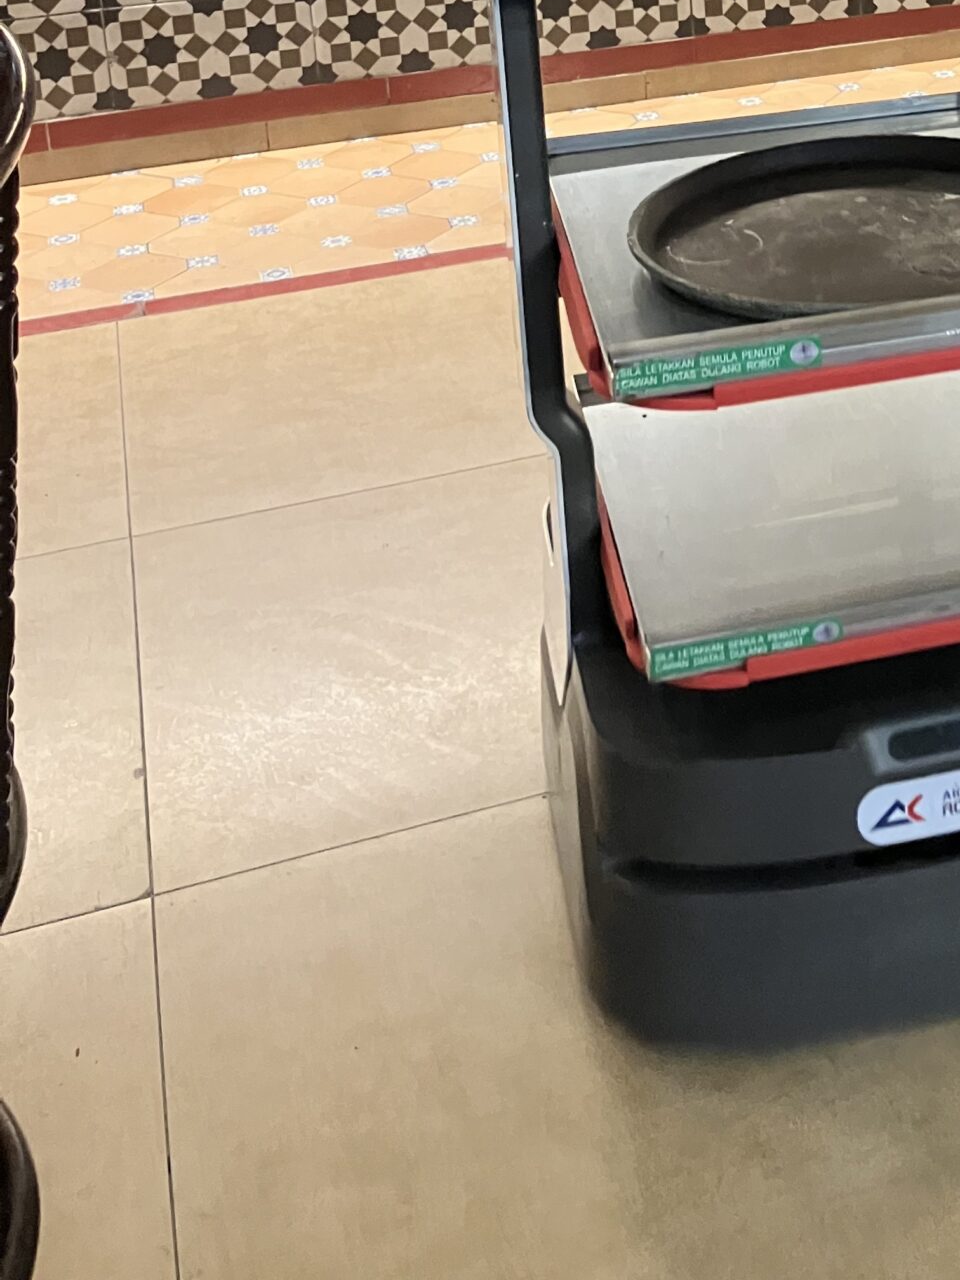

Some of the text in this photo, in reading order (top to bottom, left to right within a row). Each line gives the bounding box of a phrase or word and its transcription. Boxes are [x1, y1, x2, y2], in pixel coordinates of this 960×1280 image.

[620, 357, 781, 390] CAWAN DIATAS DULANG ROBOT
[645, 360, 695, 375] LETAKKAN
[700, 351, 738, 366] SEMULA
[741, 345, 786, 359] PENUTUP
